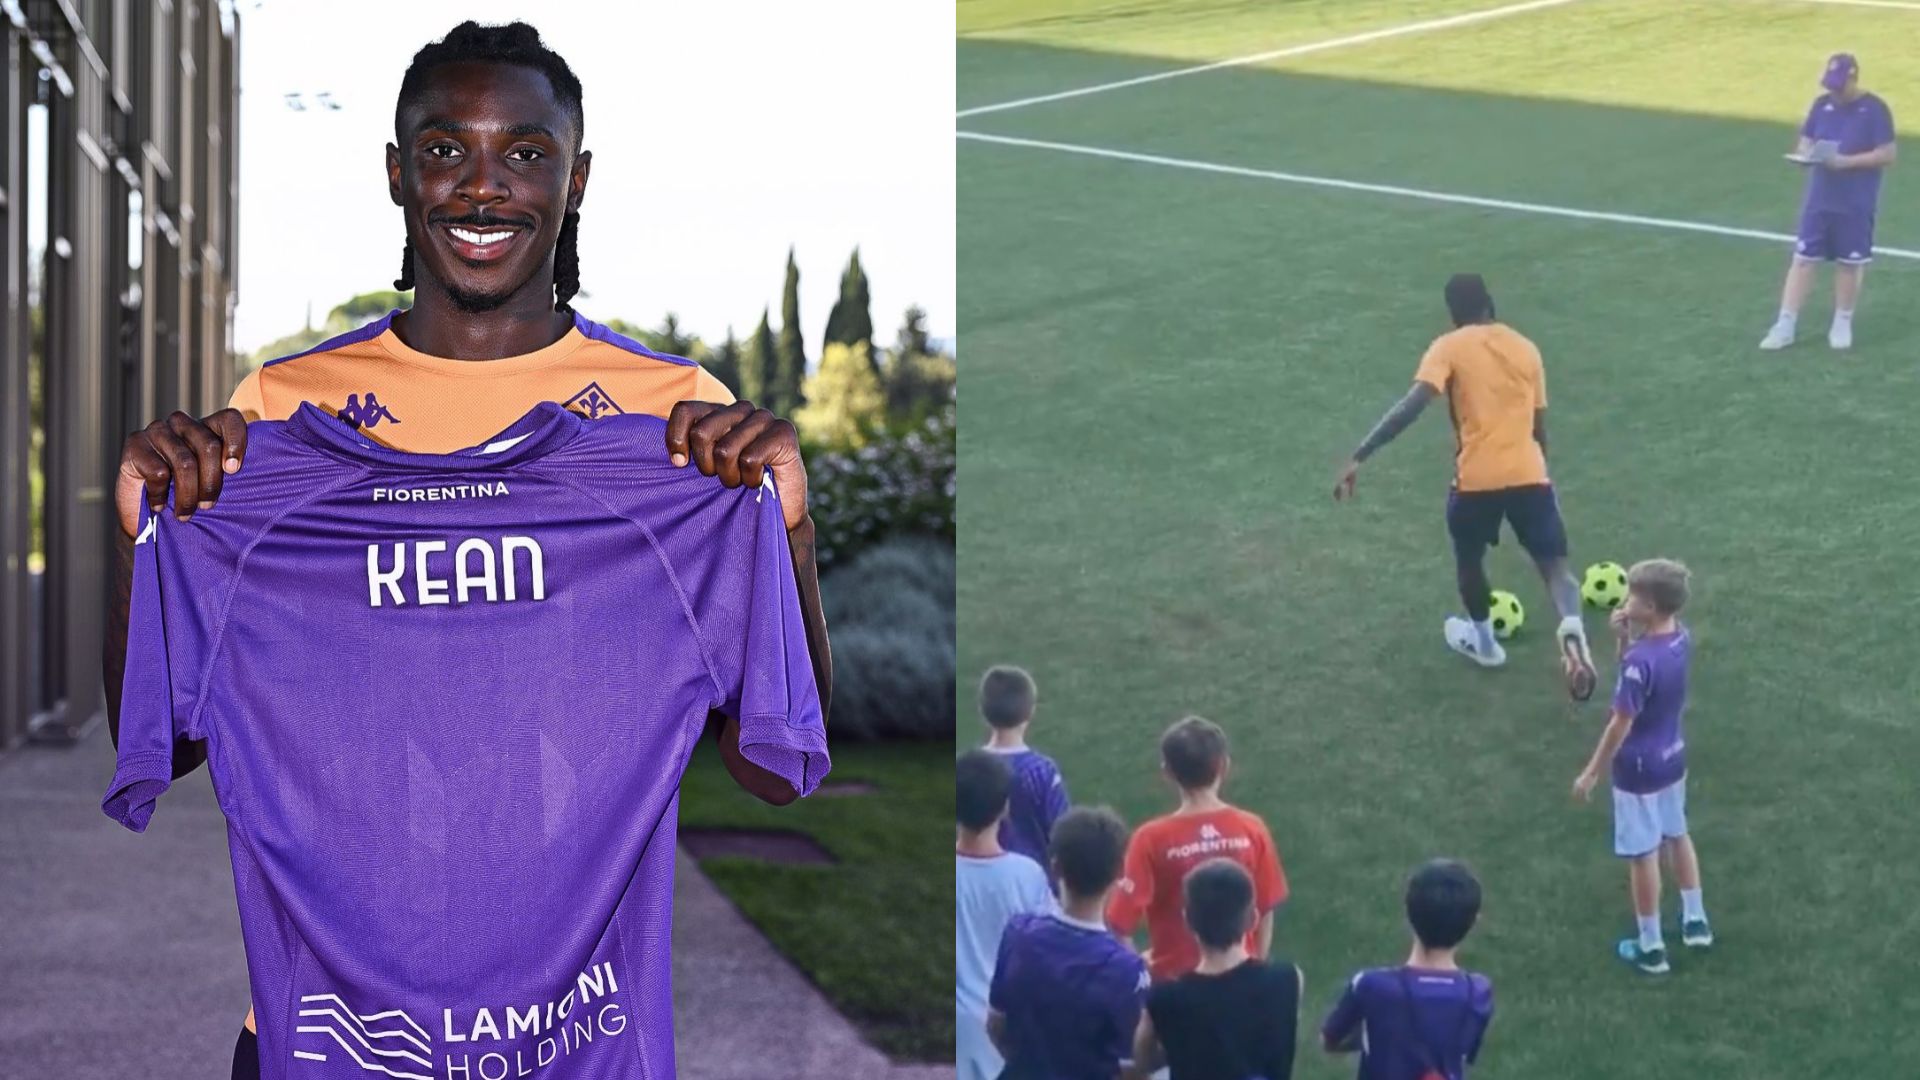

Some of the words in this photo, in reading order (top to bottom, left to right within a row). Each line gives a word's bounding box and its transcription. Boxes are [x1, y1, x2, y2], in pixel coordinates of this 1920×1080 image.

[373, 481, 509, 501] FIORENTINA
[367, 536, 545, 607] KEAN
[1167, 837, 1250, 859] FIORENTINA
[444, 961, 618, 1042] LAMIONI
[446, 1003, 626, 1080] HOLDING
